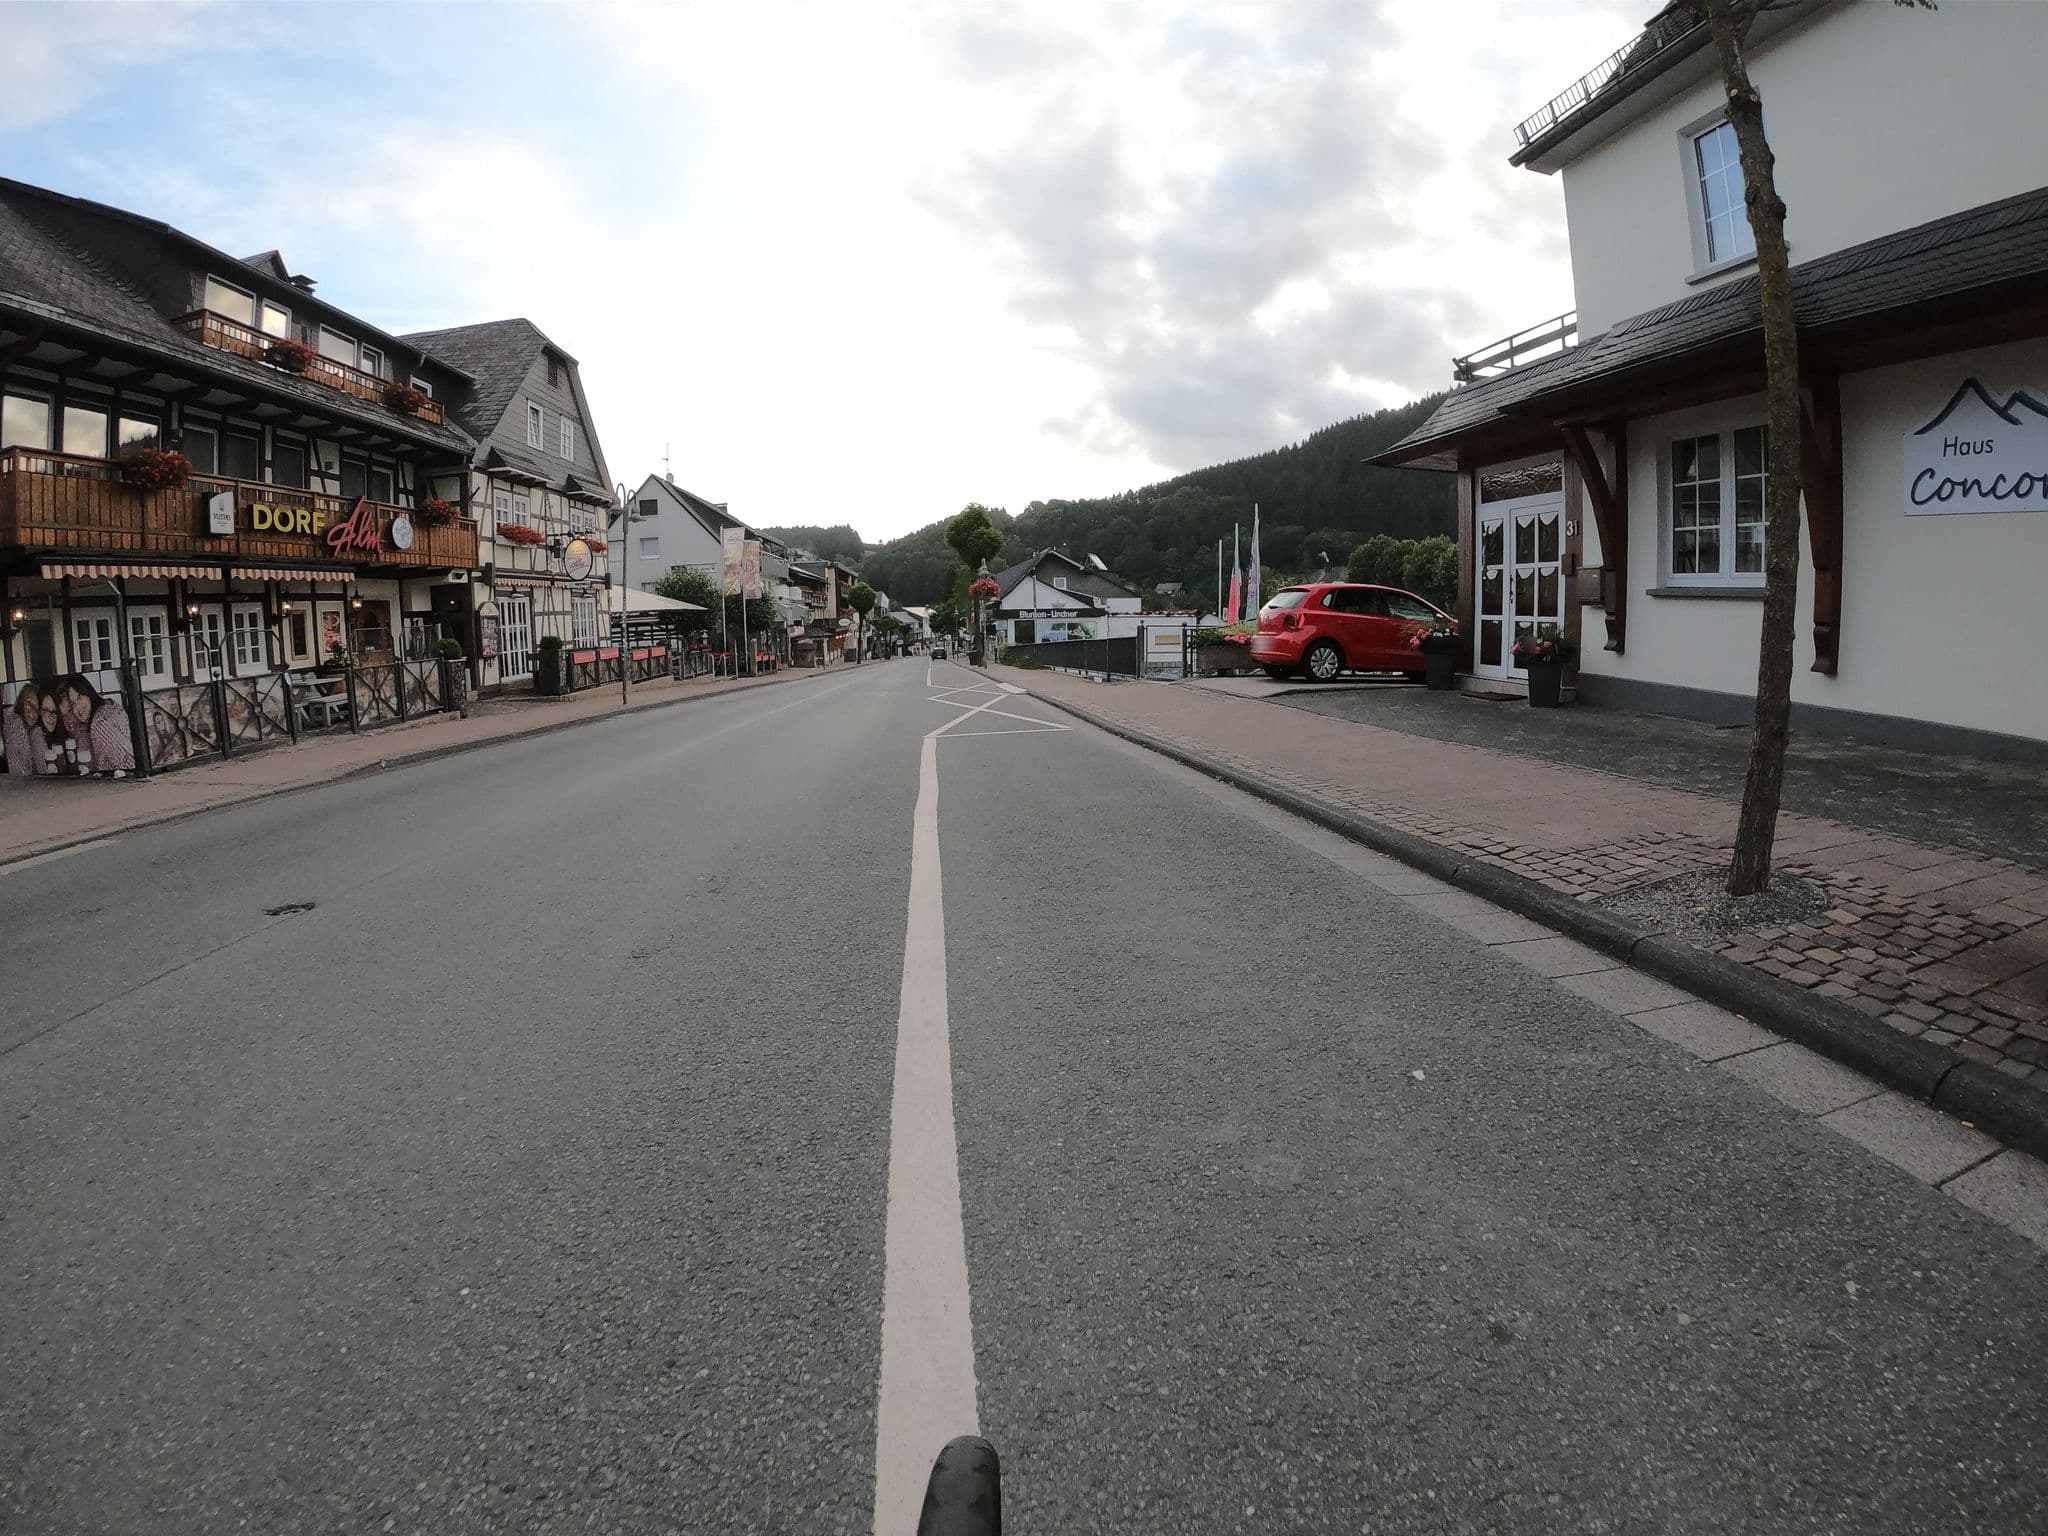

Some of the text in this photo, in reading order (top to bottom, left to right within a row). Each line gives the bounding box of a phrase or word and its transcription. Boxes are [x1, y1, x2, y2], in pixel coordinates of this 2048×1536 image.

[1943, 436, 1994, 457] Haus
[252, 503, 326, 535] DORF
[326, 495, 384, 559] Alm
[1566, 519, 1578, 537] 31
